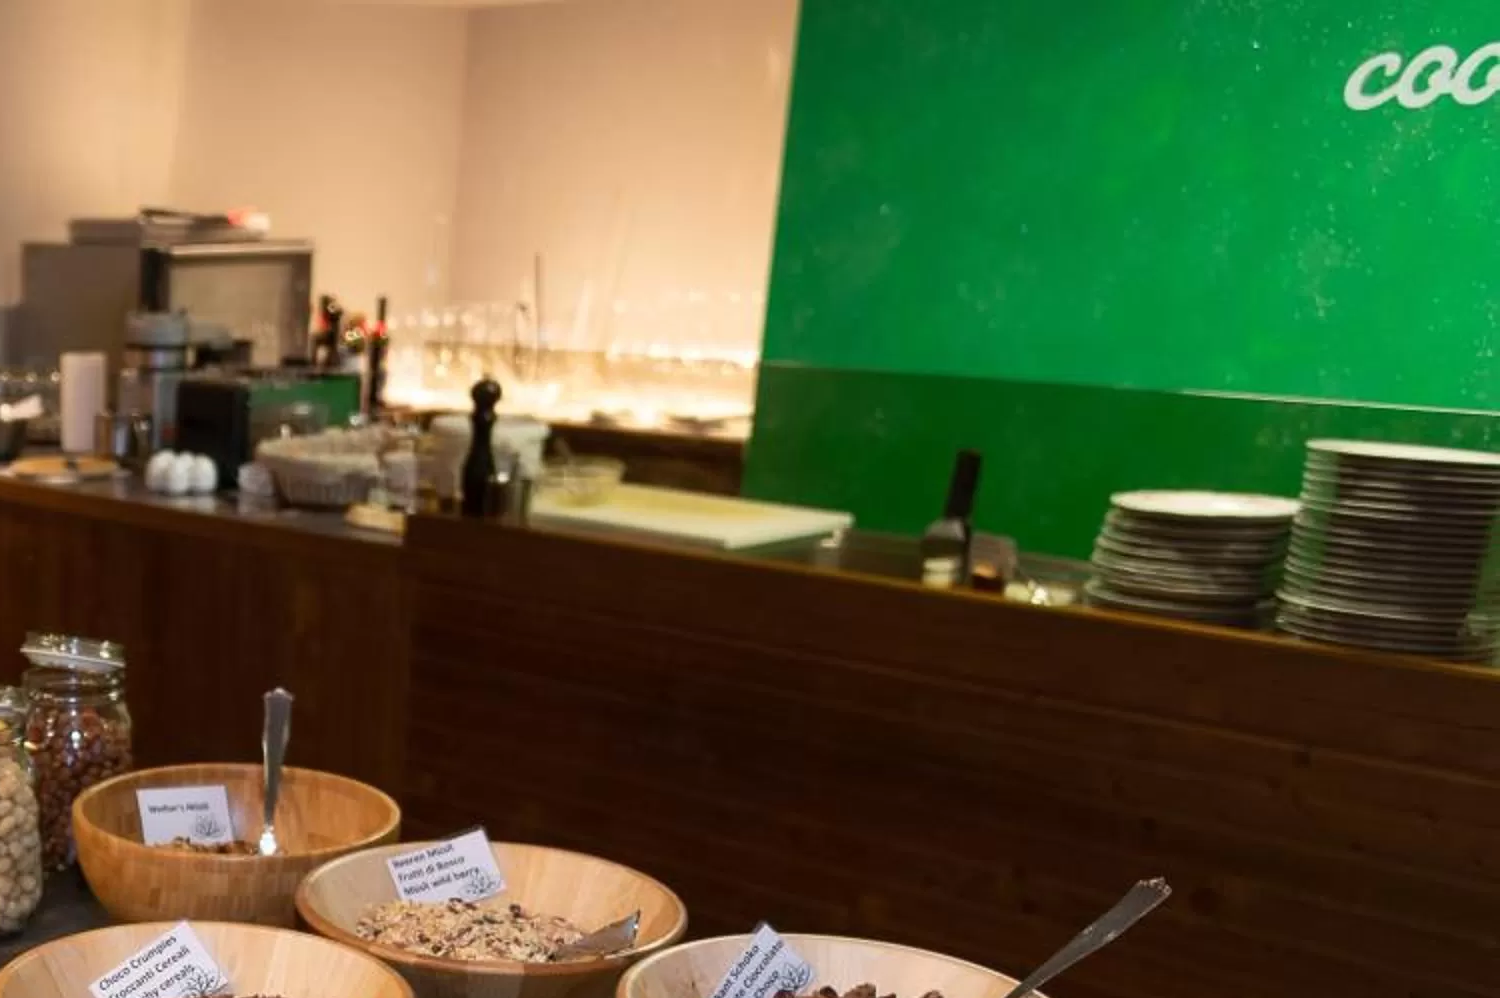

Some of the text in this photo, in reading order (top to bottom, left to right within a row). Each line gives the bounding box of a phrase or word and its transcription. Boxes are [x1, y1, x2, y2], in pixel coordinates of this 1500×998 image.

[100, 967, 130, 991] Choco
[730, 945, 760, 979] Schoko
[743, 940, 784, 989] Cioccolato
